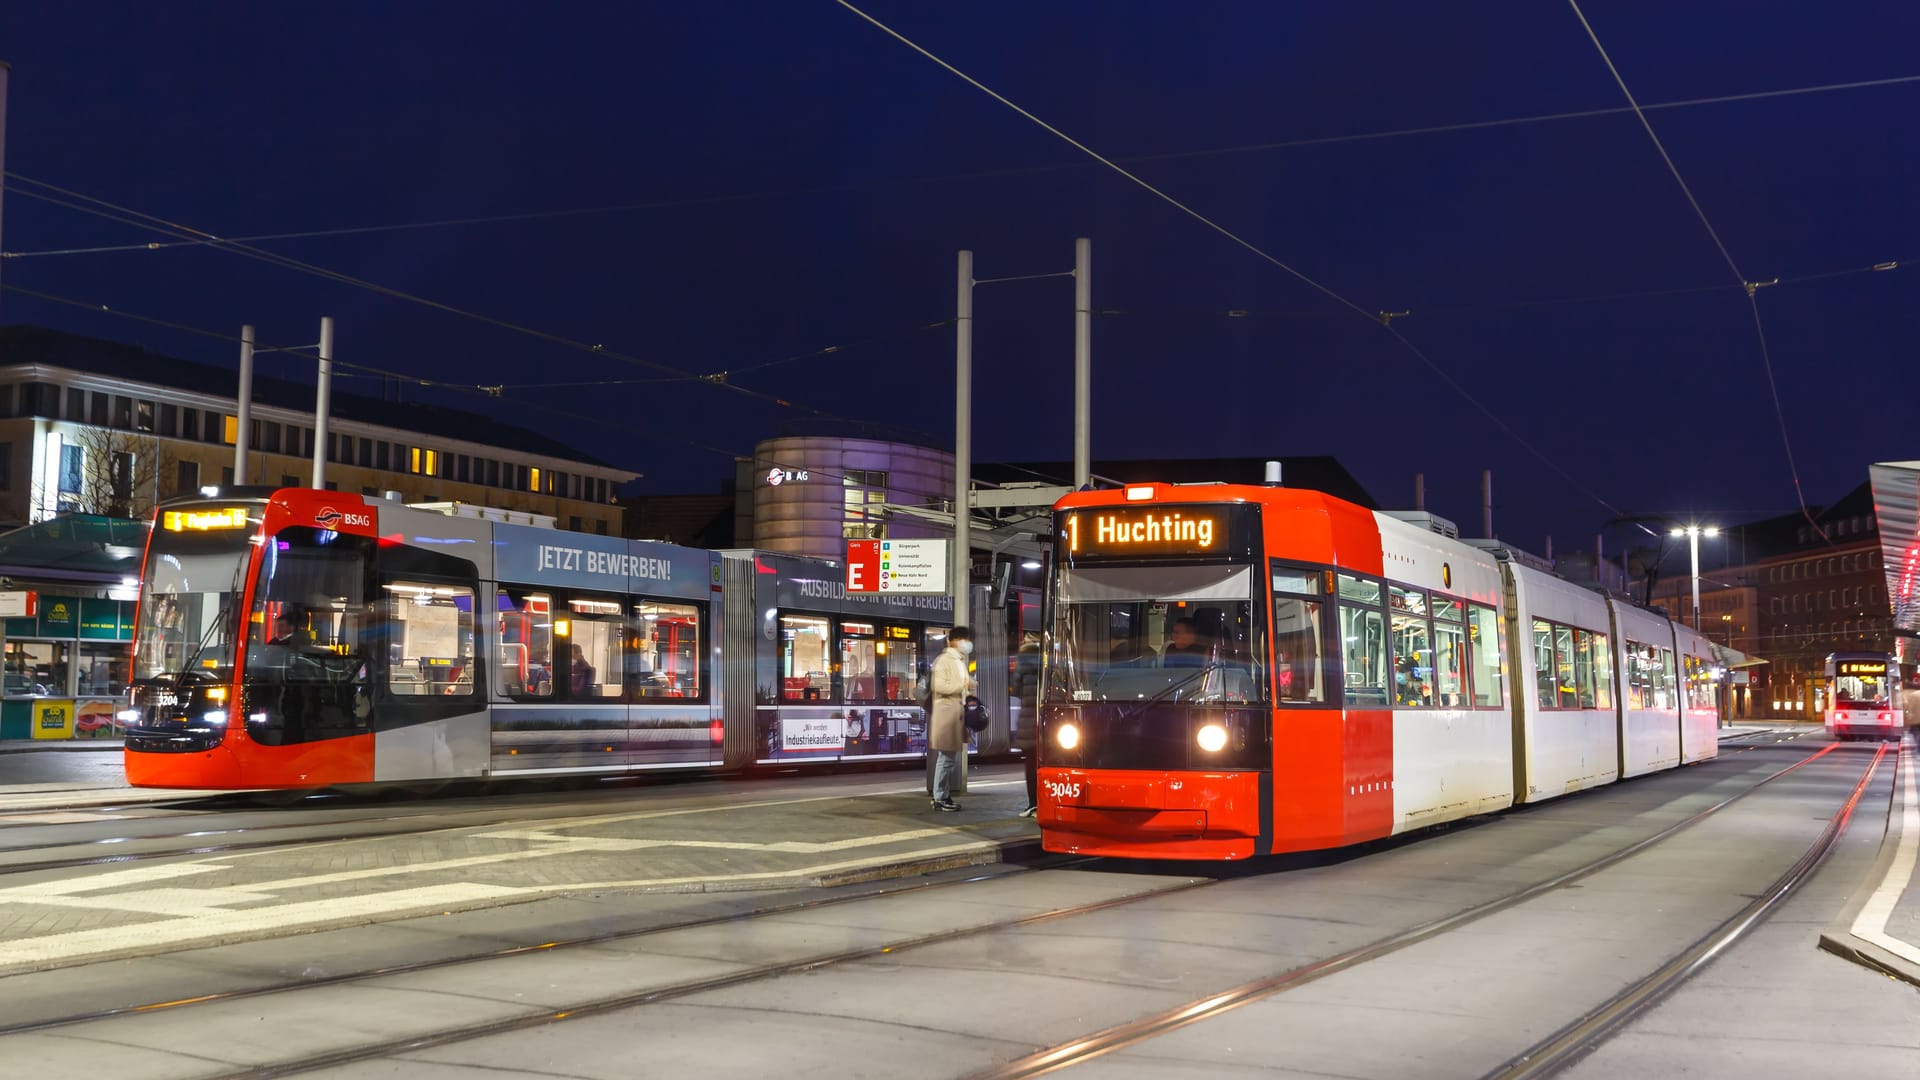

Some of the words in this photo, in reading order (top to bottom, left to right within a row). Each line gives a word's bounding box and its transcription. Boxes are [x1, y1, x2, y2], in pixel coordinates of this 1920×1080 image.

[344, 514, 370, 527] BSAG
[1068, 516, 1078, 551] 1
[1098, 514, 1213, 547] Huchting
[538, 545, 583, 572] JETZT
[587, 550, 671, 581] BEWERBEN!
[848, 563, 865, 590] E
[785, 734, 841, 746] Industriekaufleute.
[1050, 782, 1081, 798] 3045
